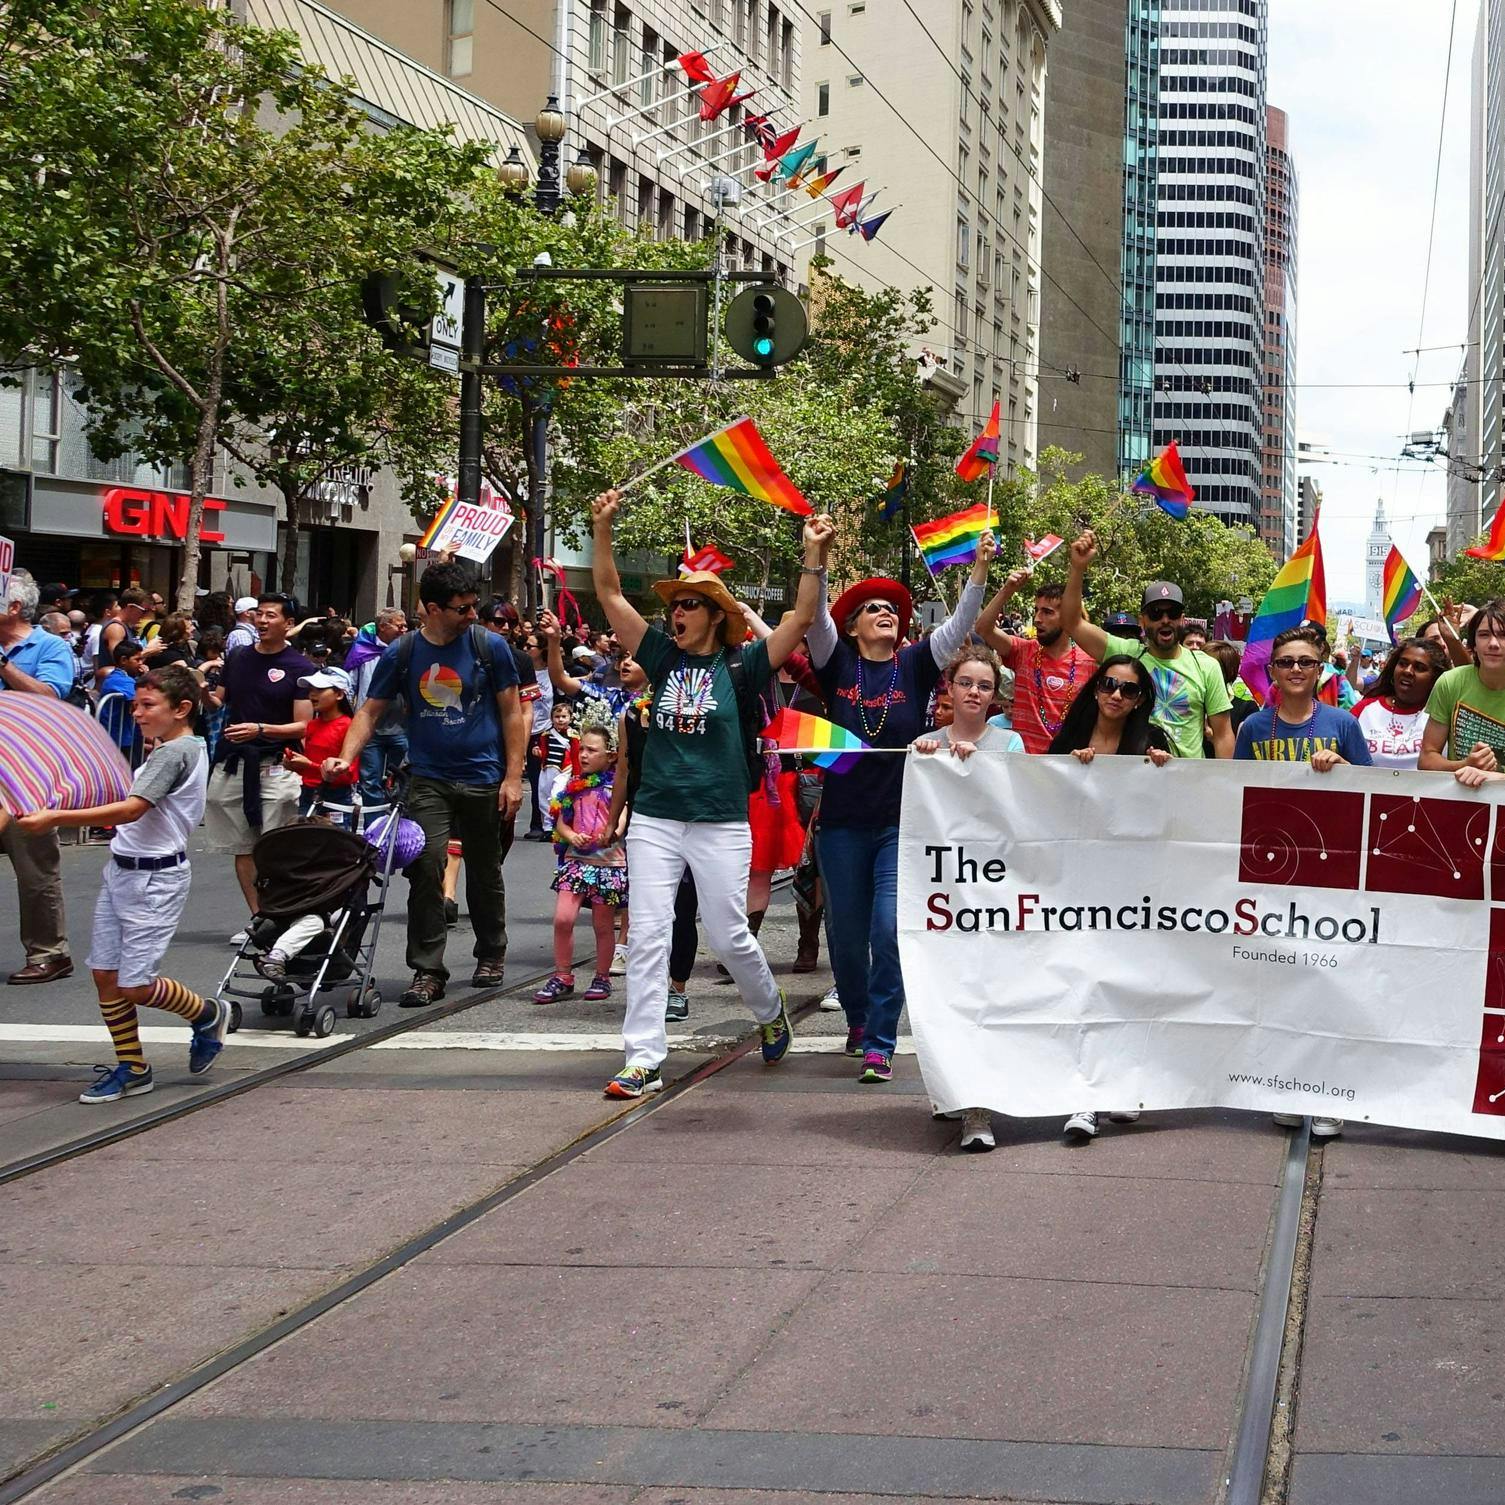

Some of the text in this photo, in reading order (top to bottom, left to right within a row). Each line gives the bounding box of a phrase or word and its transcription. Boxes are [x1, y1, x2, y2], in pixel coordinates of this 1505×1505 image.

[436, 319, 459, 339] ONLY
[450, 505, 509, 536] PROUD
[450, 528, 497, 551] FAMILY
[765, 587, 784, 601] COFFEE
[925, 845, 1006, 883] The
[1232, 945, 1338, 968] Founded 1966
[1228, 1071, 1357, 1101] www.sfschool.org
